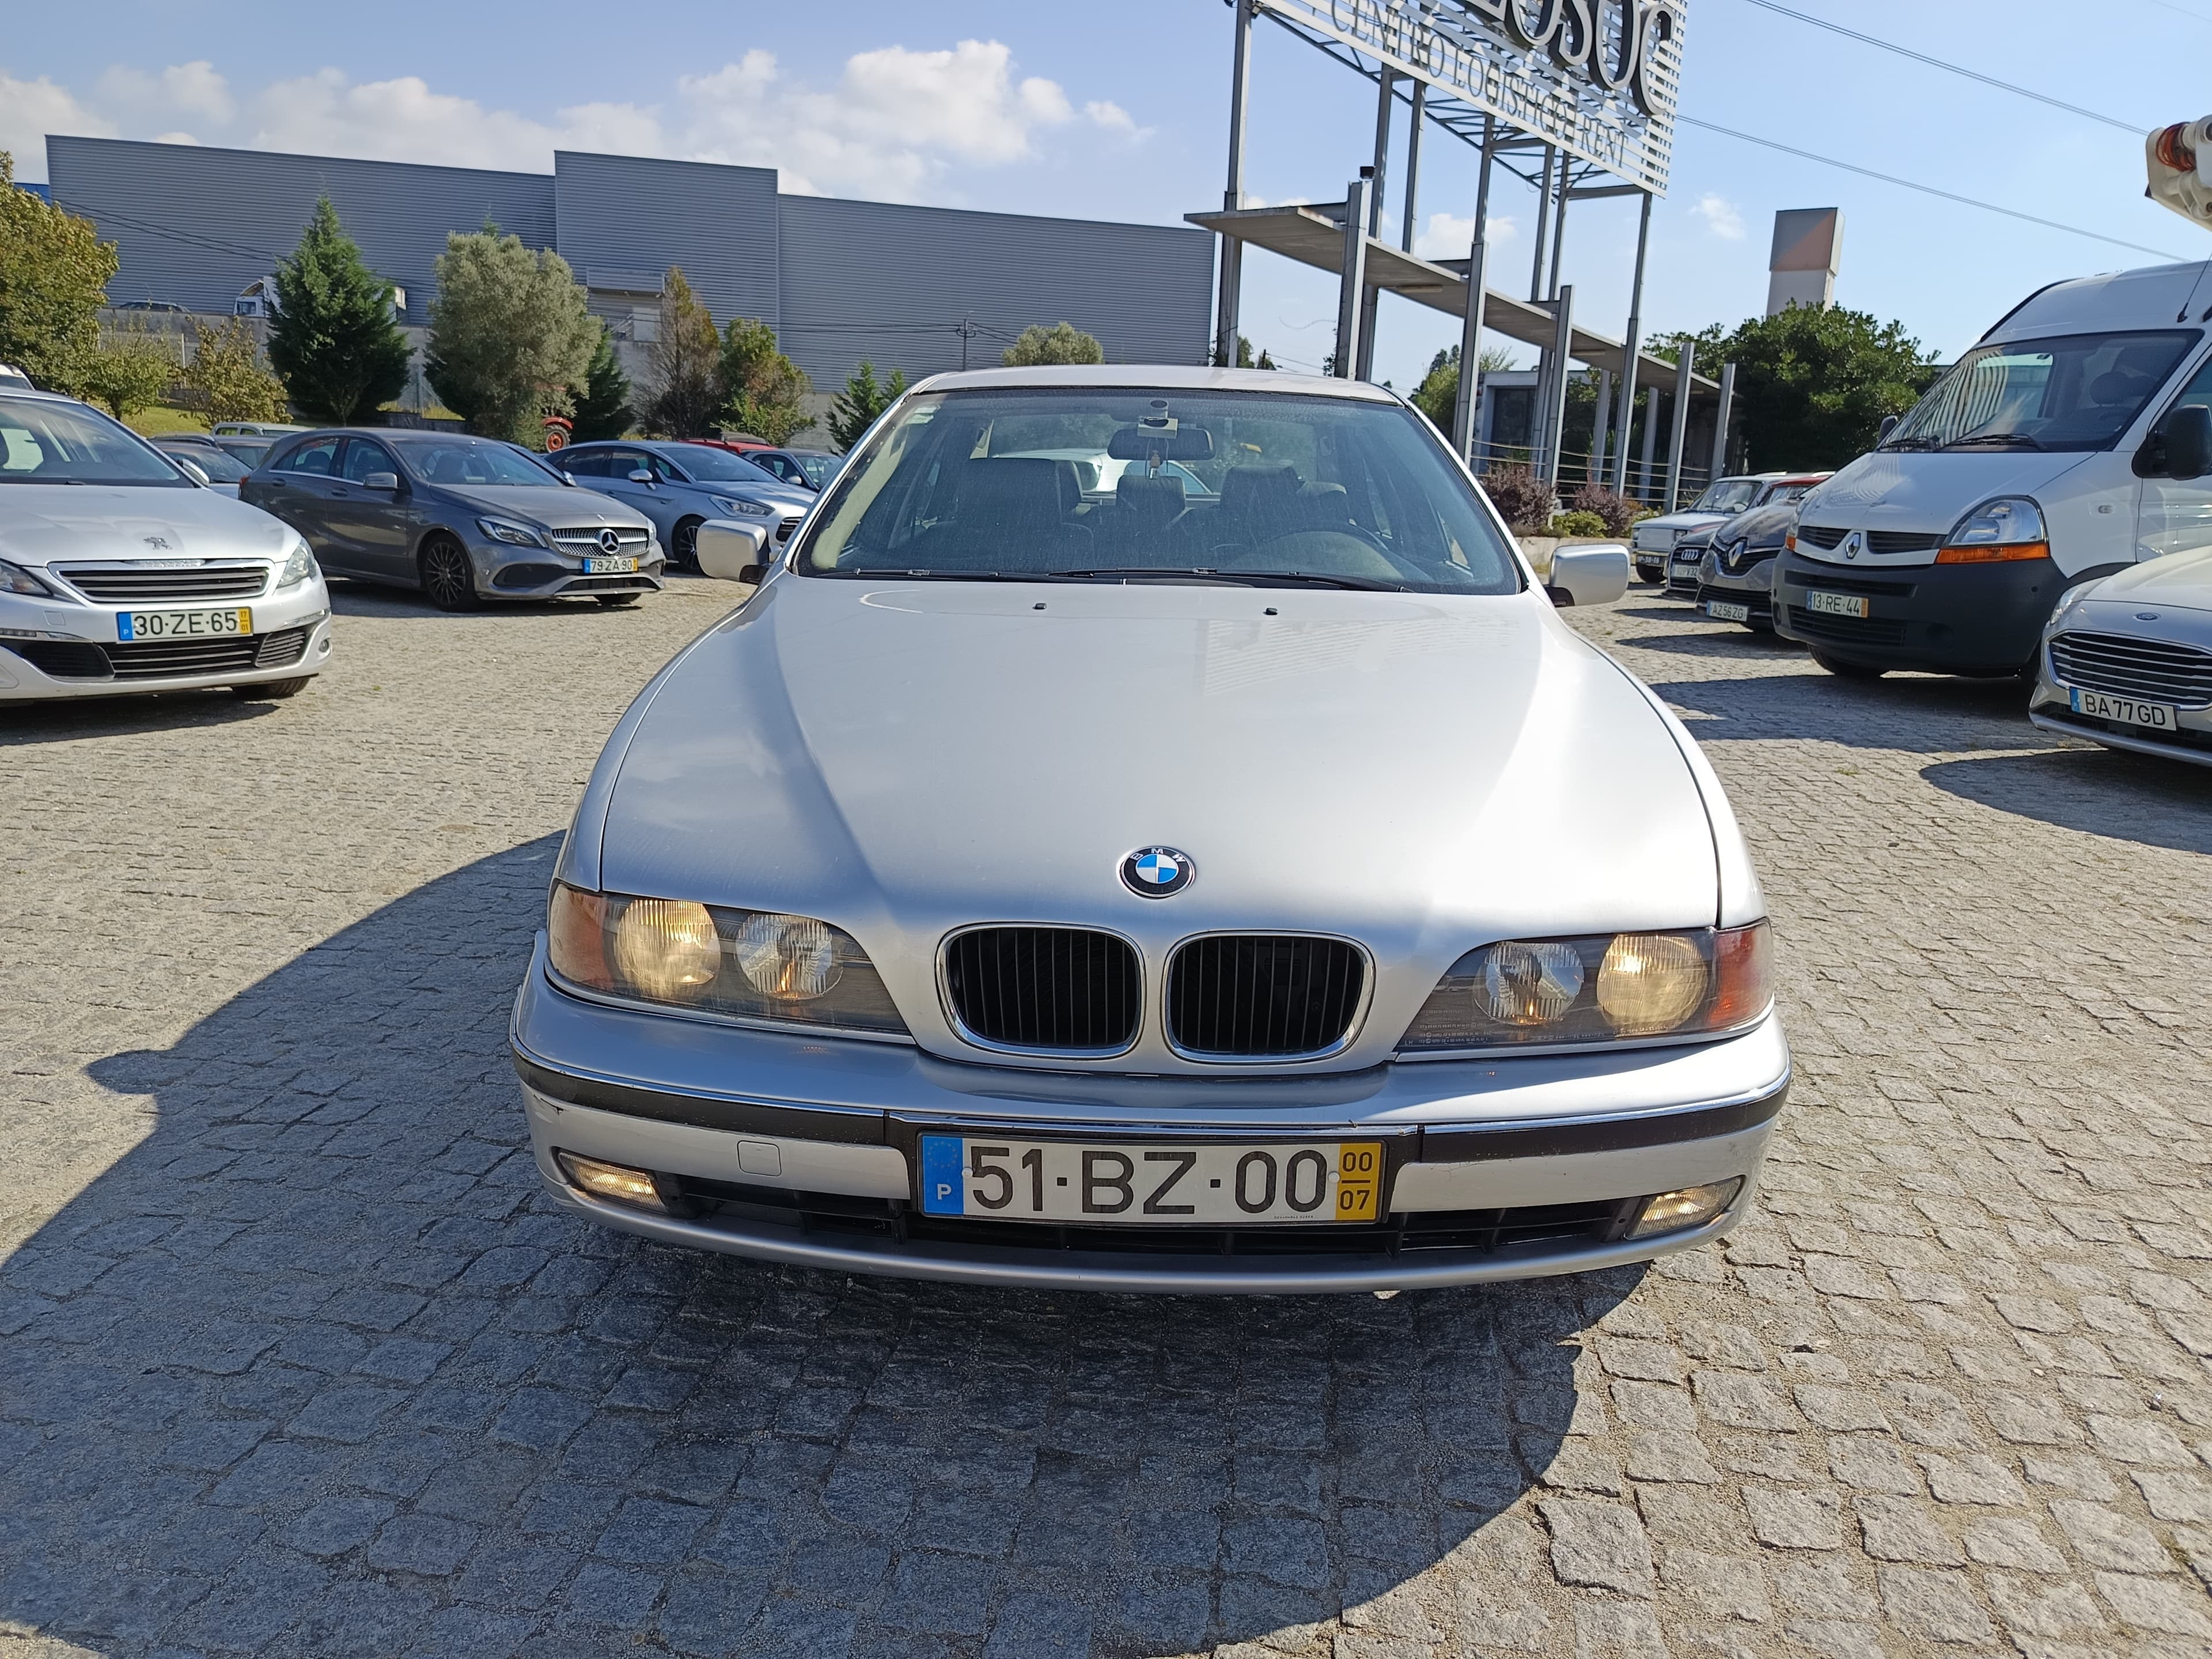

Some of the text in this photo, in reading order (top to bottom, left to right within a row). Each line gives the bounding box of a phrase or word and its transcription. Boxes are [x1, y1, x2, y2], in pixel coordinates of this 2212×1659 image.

[1130, 848, 1185, 862] BMW
[1342, 1152, 1373, 1172] 00
[937, 1183, 952, 1200] P
[1340, 1190, 1370, 1210] 07
